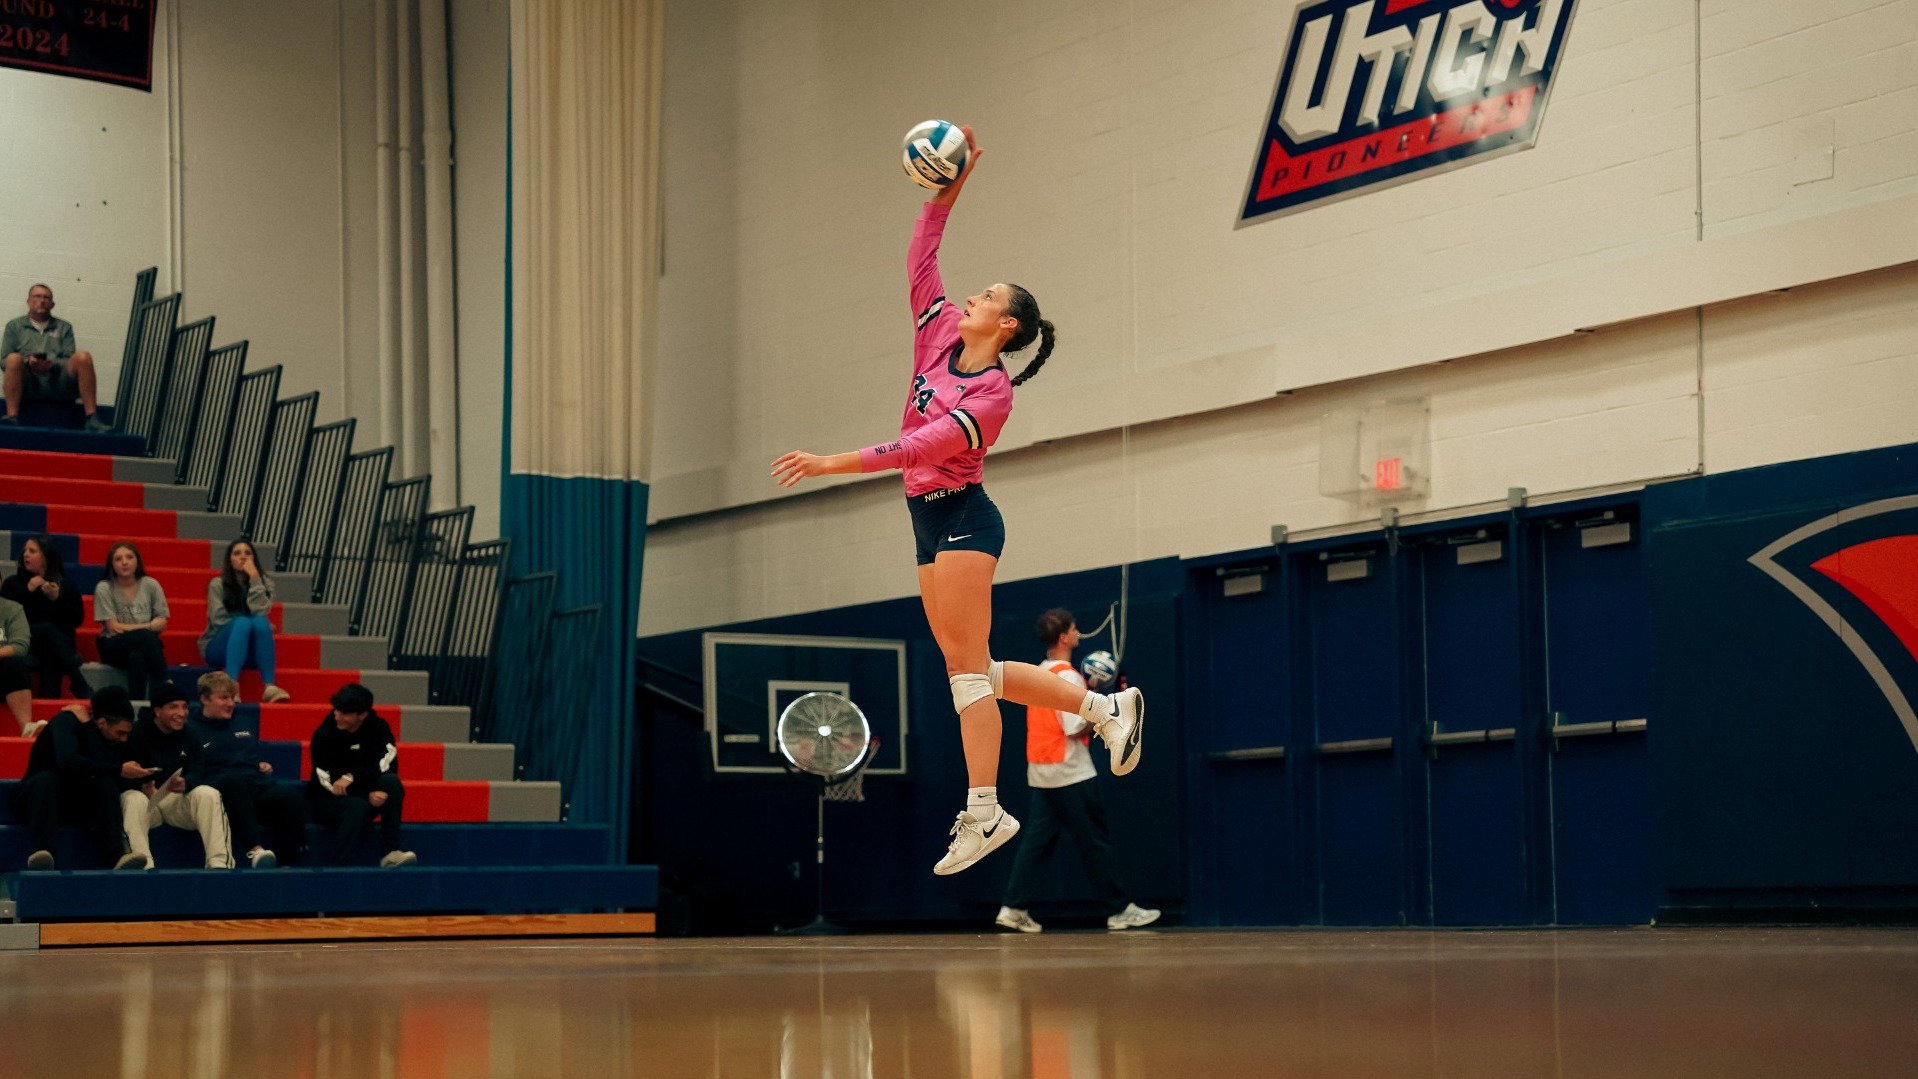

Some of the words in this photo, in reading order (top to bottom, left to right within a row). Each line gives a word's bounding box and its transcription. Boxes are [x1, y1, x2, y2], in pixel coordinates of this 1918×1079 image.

[0, 0, 55, 18] UND
[83, 8, 131, 32] 24-4
[0, 24, 69, 57] 2024
[1277, 0, 1562, 145] UTICA
[1271, 92, 1523, 190] PIONEERS
[874, 445, 887, 456] ON
[1376, 457, 1402, 490] EXIT
[924, 489, 946, 503] NIKE
